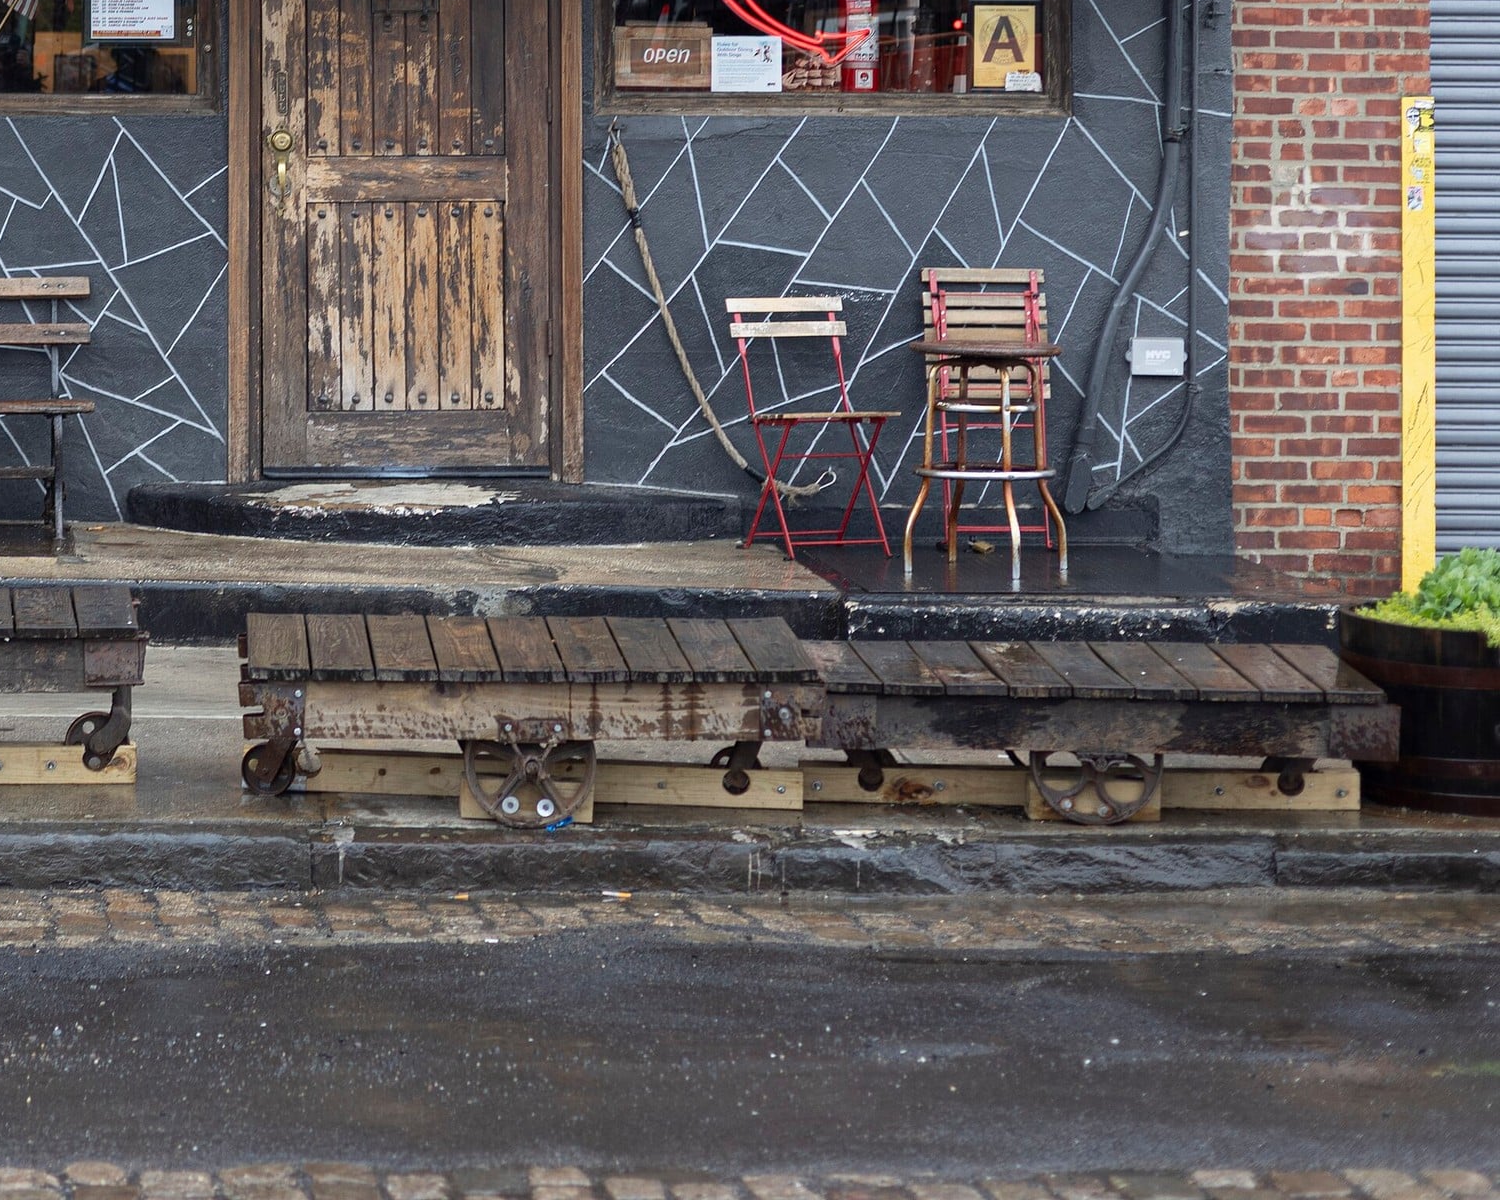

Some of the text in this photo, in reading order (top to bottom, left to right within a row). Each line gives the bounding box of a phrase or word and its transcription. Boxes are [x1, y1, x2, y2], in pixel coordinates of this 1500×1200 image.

[982, 15, 1024, 63] A
[643, 47, 691, 64] open
[1145, 350, 1171, 360] NYC
